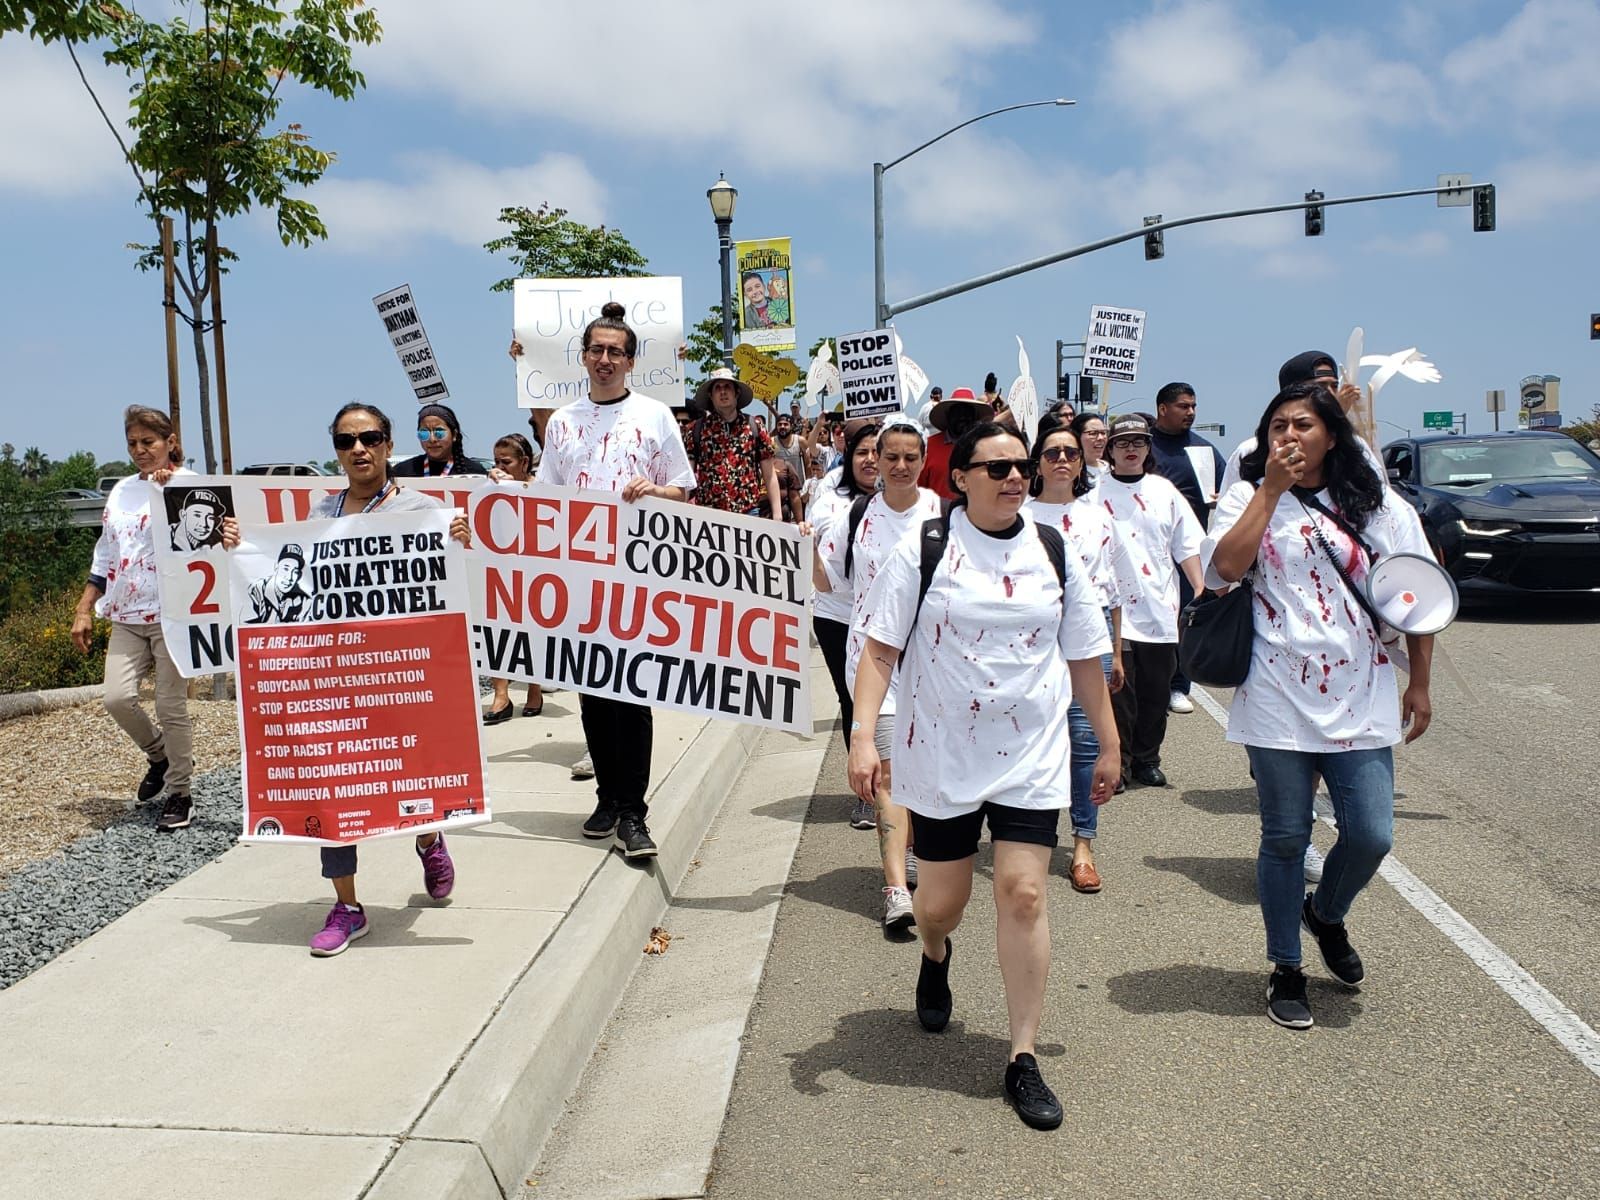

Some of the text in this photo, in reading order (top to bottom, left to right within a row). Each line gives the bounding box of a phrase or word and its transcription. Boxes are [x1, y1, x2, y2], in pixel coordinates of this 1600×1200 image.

[738, 255, 790, 272] COUNTY FAIR
[395, 292, 411, 306] FOR
[1096, 310, 1132, 323] JUSTICE
[1093, 322, 1139, 341] ALL VICTIMS
[840, 334, 890, 355] STOP
[1090, 344, 1136, 359] of POLICE
[405, 347, 432, 365] POLICE
[841, 354, 893, 372] POLICE
[1089, 357, 1134, 371] TERROR!
[408, 364, 437, 382] TERROR!
[751, 371, 768, 386] 22
[843, 374, 896, 389] BRUTALITY
[845, 386, 896, 407] NOW!
[310, 531, 445, 563] JUSTICE FOR
[627, 508, 802, 570] JONATHON
[310, 555, 447, 596] JONATHON
[625, 540, 805, 606] CORONEL
[311, 585, 447, 622] CORONEL
[187, 560, 800, 672] 2 NO JUSTICE
[248, 631, 366, 650] WE ARE CALLING FOR:
[259, 647, 431, 672] INDEPENDENT INVESTIGATION
[257, 669, 425, 693] BODYCAM IMPLEMENTATION
[545, 636, 801, 724] INDICTMENT
[260, 690, 433, 715] STOP EXCESSIVE MONITORING
[264, 717, 368, 737] AND HARASSMENT
[264, 734, 417, 758] STOP RACIST PRACTICE OF
[267, 757, 403, 780] GANG DOCUMENTATION
[267, 773, 469, 802] VILLANUEVA MURDER INDICTMENT
[338, 810, 371, 819] SHOWING
[338, 821, 349, 829] UP
[340, 830, 365, 838] RACIAL
